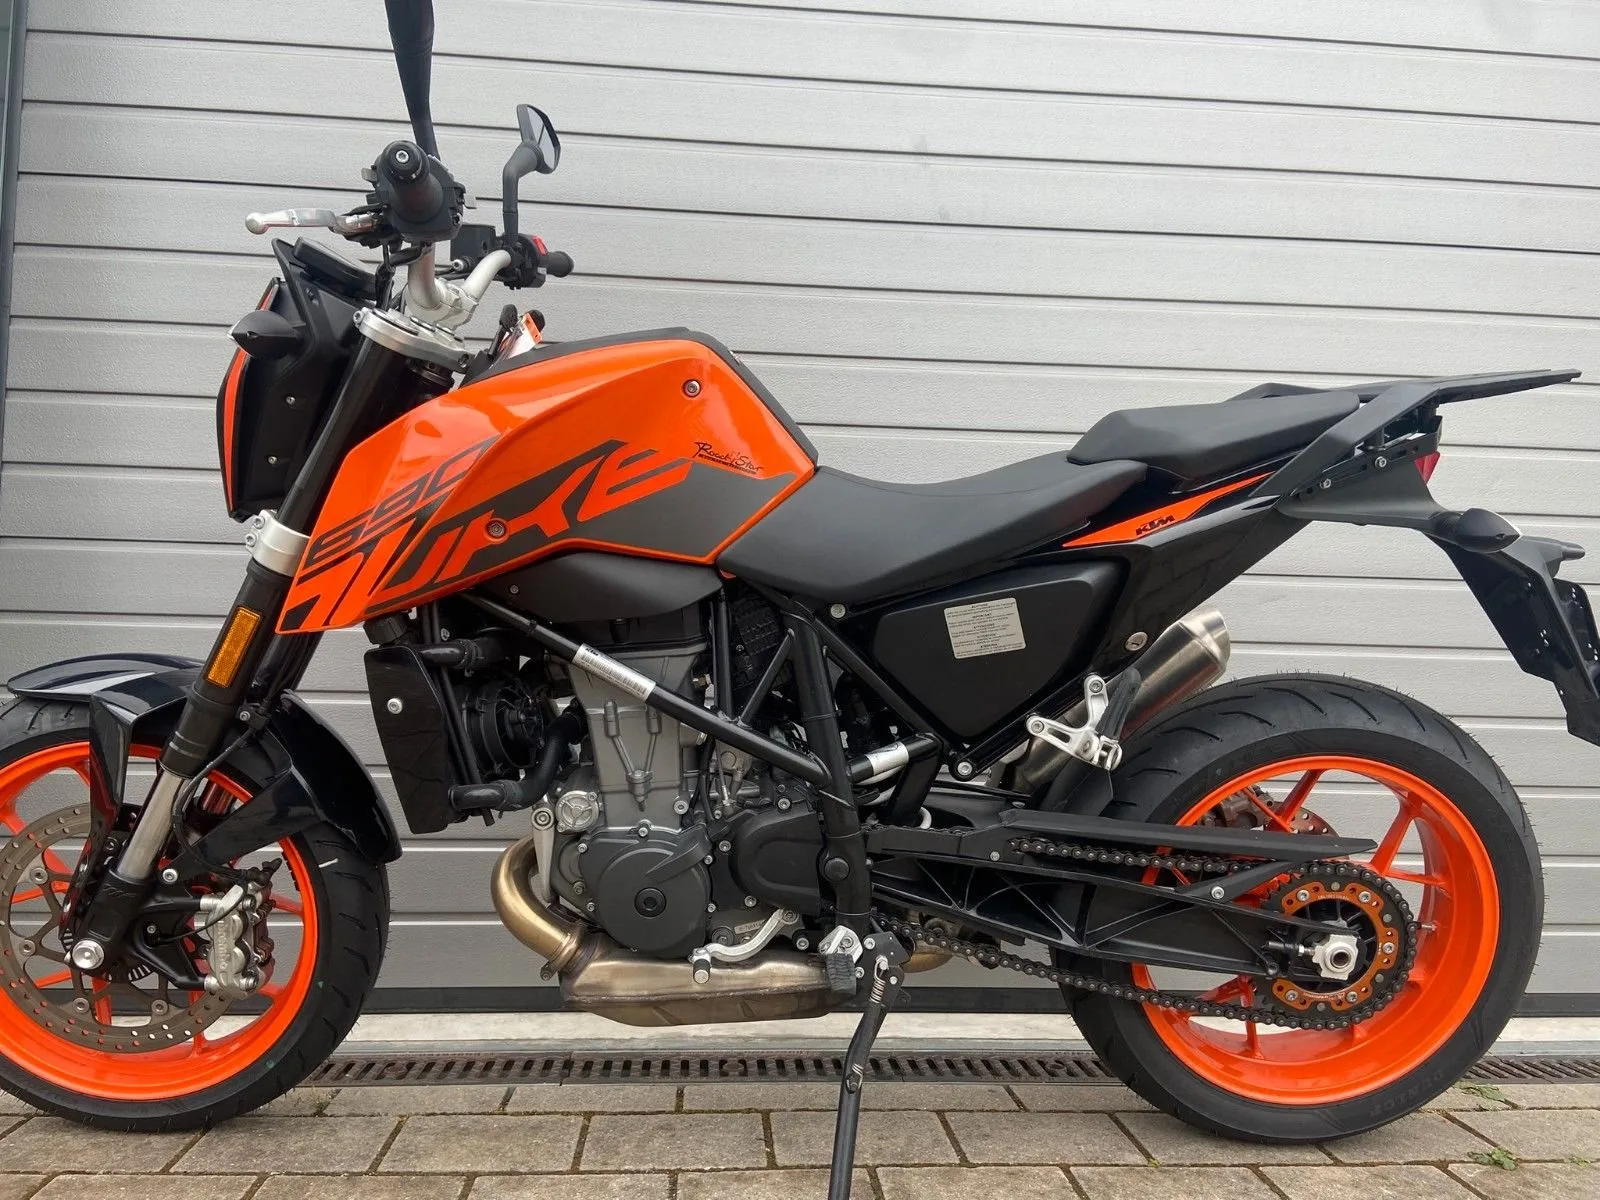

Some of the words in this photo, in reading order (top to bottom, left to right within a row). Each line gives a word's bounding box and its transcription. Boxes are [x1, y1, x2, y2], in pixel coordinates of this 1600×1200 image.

[278, 446, 694, 631] DUKE
[301, 433, 500, 569] 690
[1136, 515, 1175, 535] KTM
